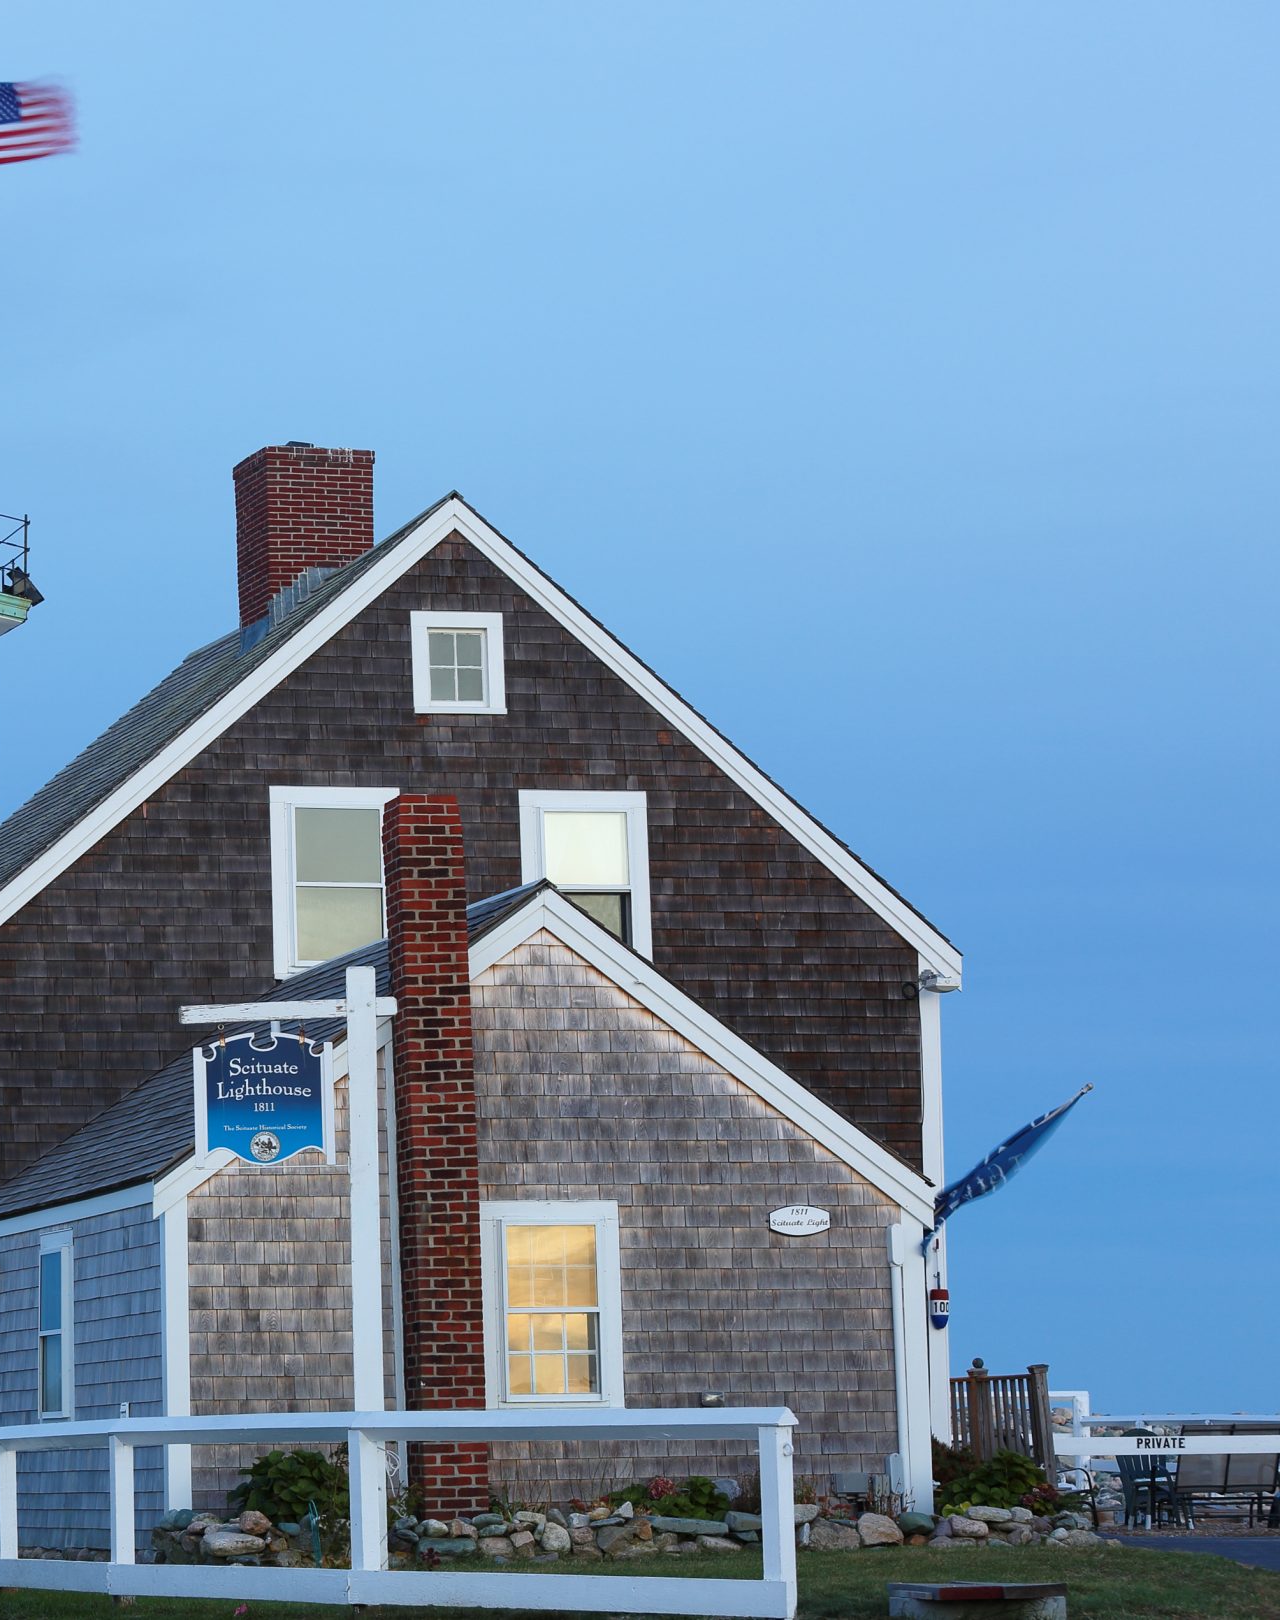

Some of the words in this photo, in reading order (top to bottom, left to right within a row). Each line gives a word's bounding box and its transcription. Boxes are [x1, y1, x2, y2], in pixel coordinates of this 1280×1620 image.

[228, 1057, 299, 1076] Scituate
[216, 1078, 312, 1101] Lighthouse
[253, 1102, 275, 1112] 1811
[286, 1123, 307, 1131] Society
[790, 1208, 809, 1216] 1811
[771, 1218, 804, 1227] Scituate
[806, 1218, 828, 1228] Light
[1136, 1437, 1186, 1449] PRIVATE
